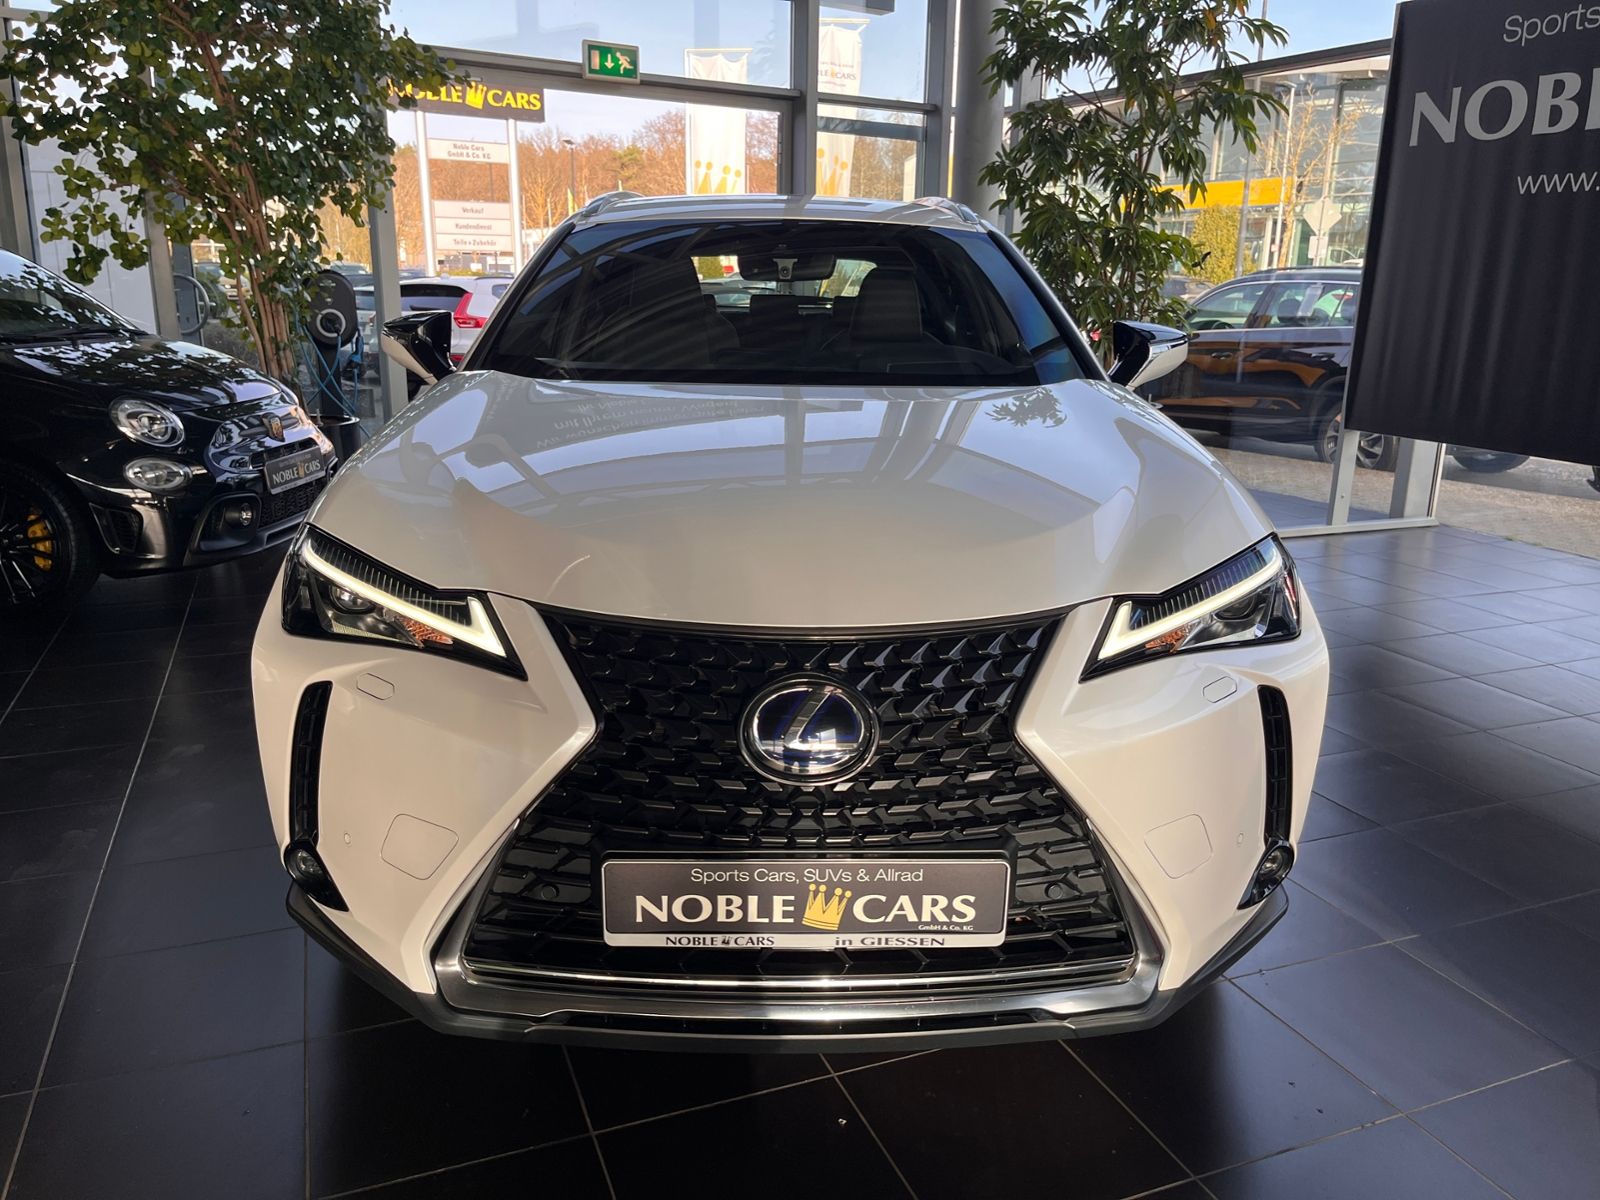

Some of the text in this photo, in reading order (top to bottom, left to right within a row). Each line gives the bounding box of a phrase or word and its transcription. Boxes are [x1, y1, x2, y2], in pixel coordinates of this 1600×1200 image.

[1503, 4, 1600, 46] Sports
[486, 89, 542, 111] CARS
[462, 206, 484, 214] Verkauf
[455, 223, 492, 231] Kundendienst
[272, 466, 298, 485] NOBLE
[304, 459, 320, 474] CARS
[691, 868, 924, 884] Sports Cars, SUVs & Allrad
[635, 894, 976, 923] NOBLE CARS
[665, 936, 945, 946] NOBLE CARS in GIESSEN
